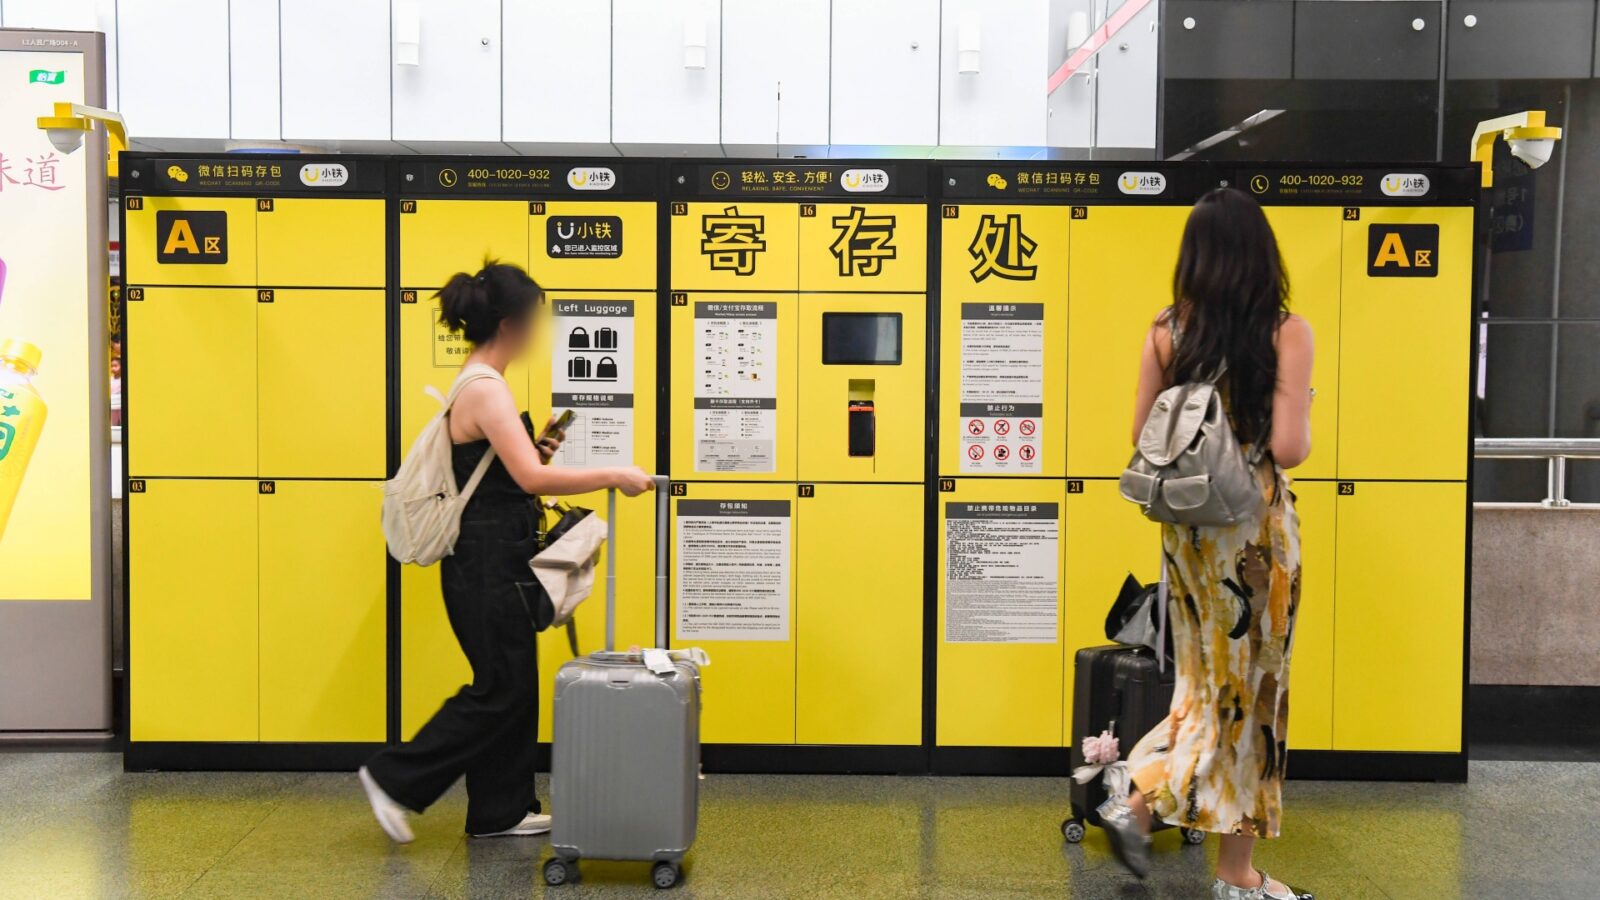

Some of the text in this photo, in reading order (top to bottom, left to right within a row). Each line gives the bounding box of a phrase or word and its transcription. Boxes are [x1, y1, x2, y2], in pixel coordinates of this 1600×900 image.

[198, 165, 281, 178] 微信扫码存包
[321, 167, 343, 178] 小铁
[467, 169, 550, 180] 400-1020-932
[589, 171, 610, 182] 小铁
[862, 173, 884, 183] 小铁
[1017, 172, 1100, 184] 微信扫码存包
[1140, 176, 1161, 187] 小铁
[1279, 175, 1363, 185] 400-1020-932
[1402, 178, 1424, 188] 小铁
[130, 199, 139, 209] 01
[260, 200, 270, 210] 04
[403, 202, 413, 212] 07
[533, 204, 542, 213] 10
[675, 205, 685, 214] 13
[803, 206, 813, 215] 16
[946, 207, 955, 216] 18
[1075, 208, 1084, 217] 20
[1346, 209, 1356, 219] 24
[577, 221, 612, 239] 小铁
[130, 290, 140, 299] 02
[260, 292, 270, 301] 05
[403, 292, 414, 302] 08
[674, 295, 684, 304] 14
[558, 304, 628, 314] Left Luggage
[132, 481, 142, 491] 03
[262, 483, 272, 492] 06
[674, 485, 683, 494] 15
[943, 481, 952, 490] 19
[1070, 482, 1080, 491] 21
[1341, 484, 1352, 493] 25
[802, 487, 811, 496] 17
